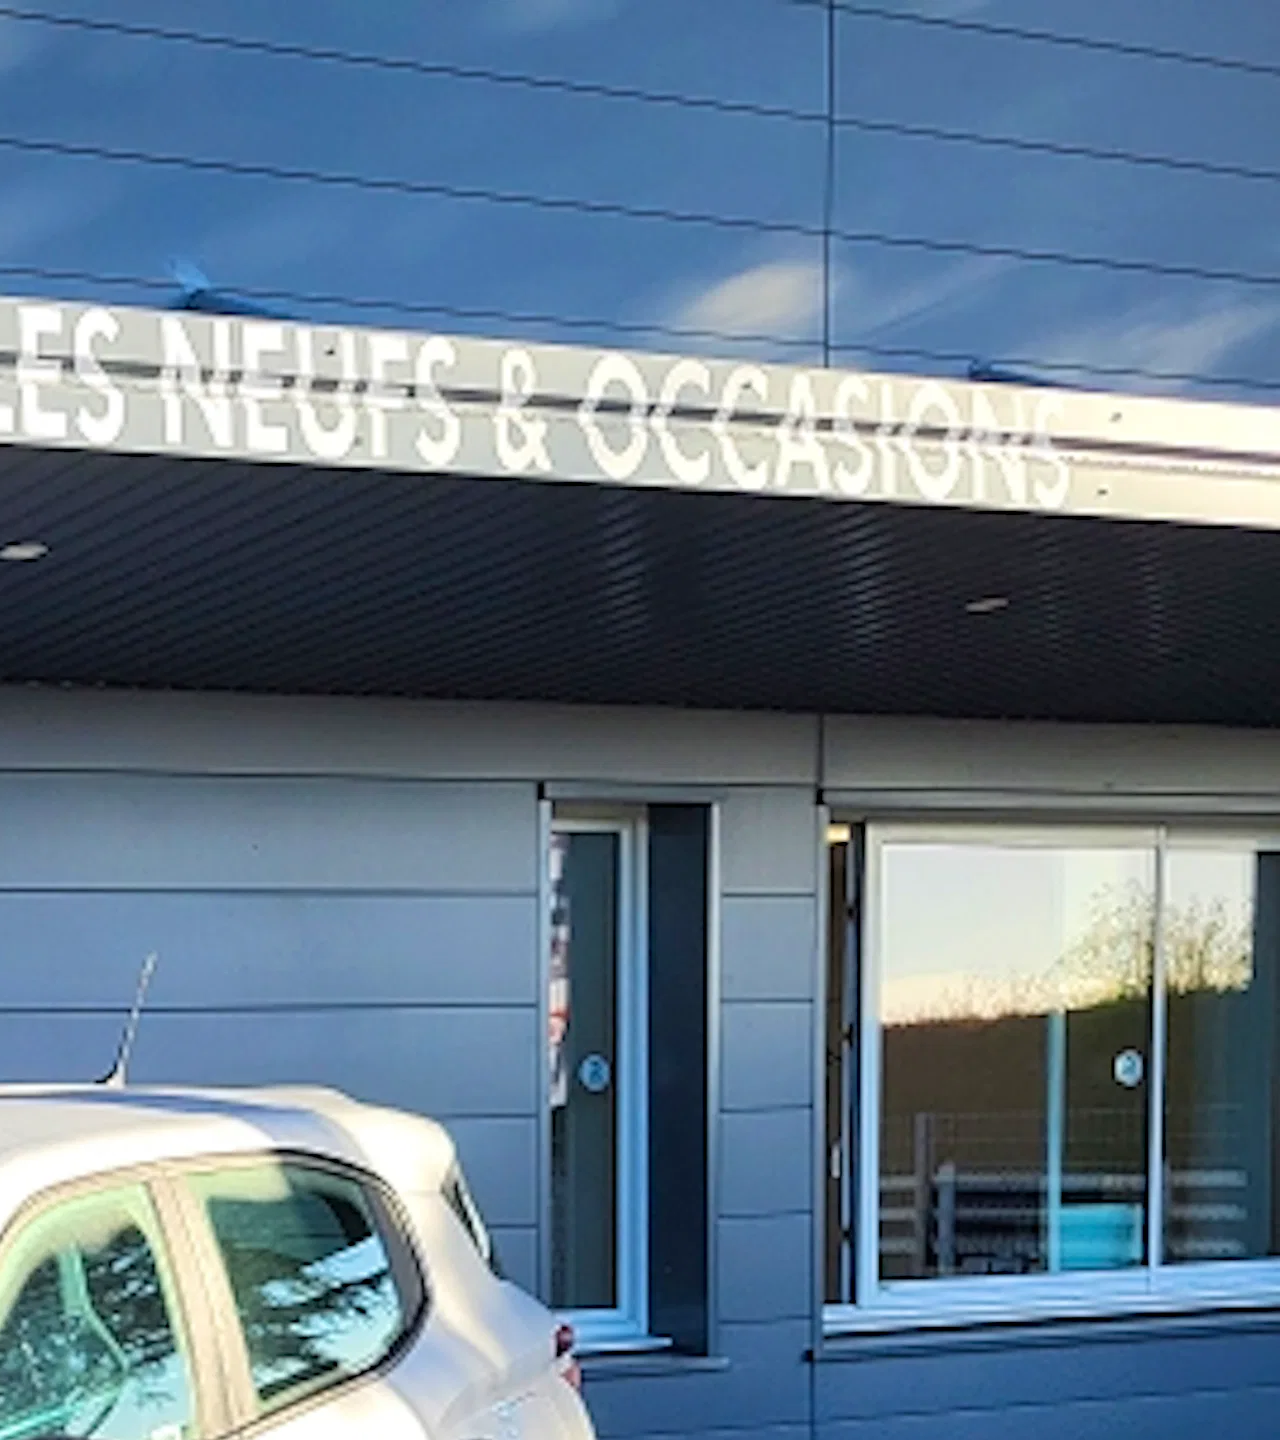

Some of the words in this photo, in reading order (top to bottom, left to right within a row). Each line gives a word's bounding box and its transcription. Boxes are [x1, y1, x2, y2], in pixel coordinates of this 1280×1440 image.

[158, 317, 462, 472] NEUFS
[493, 348, 554, 474] &
[579, 352, 1070, 510] OCCASIONS
